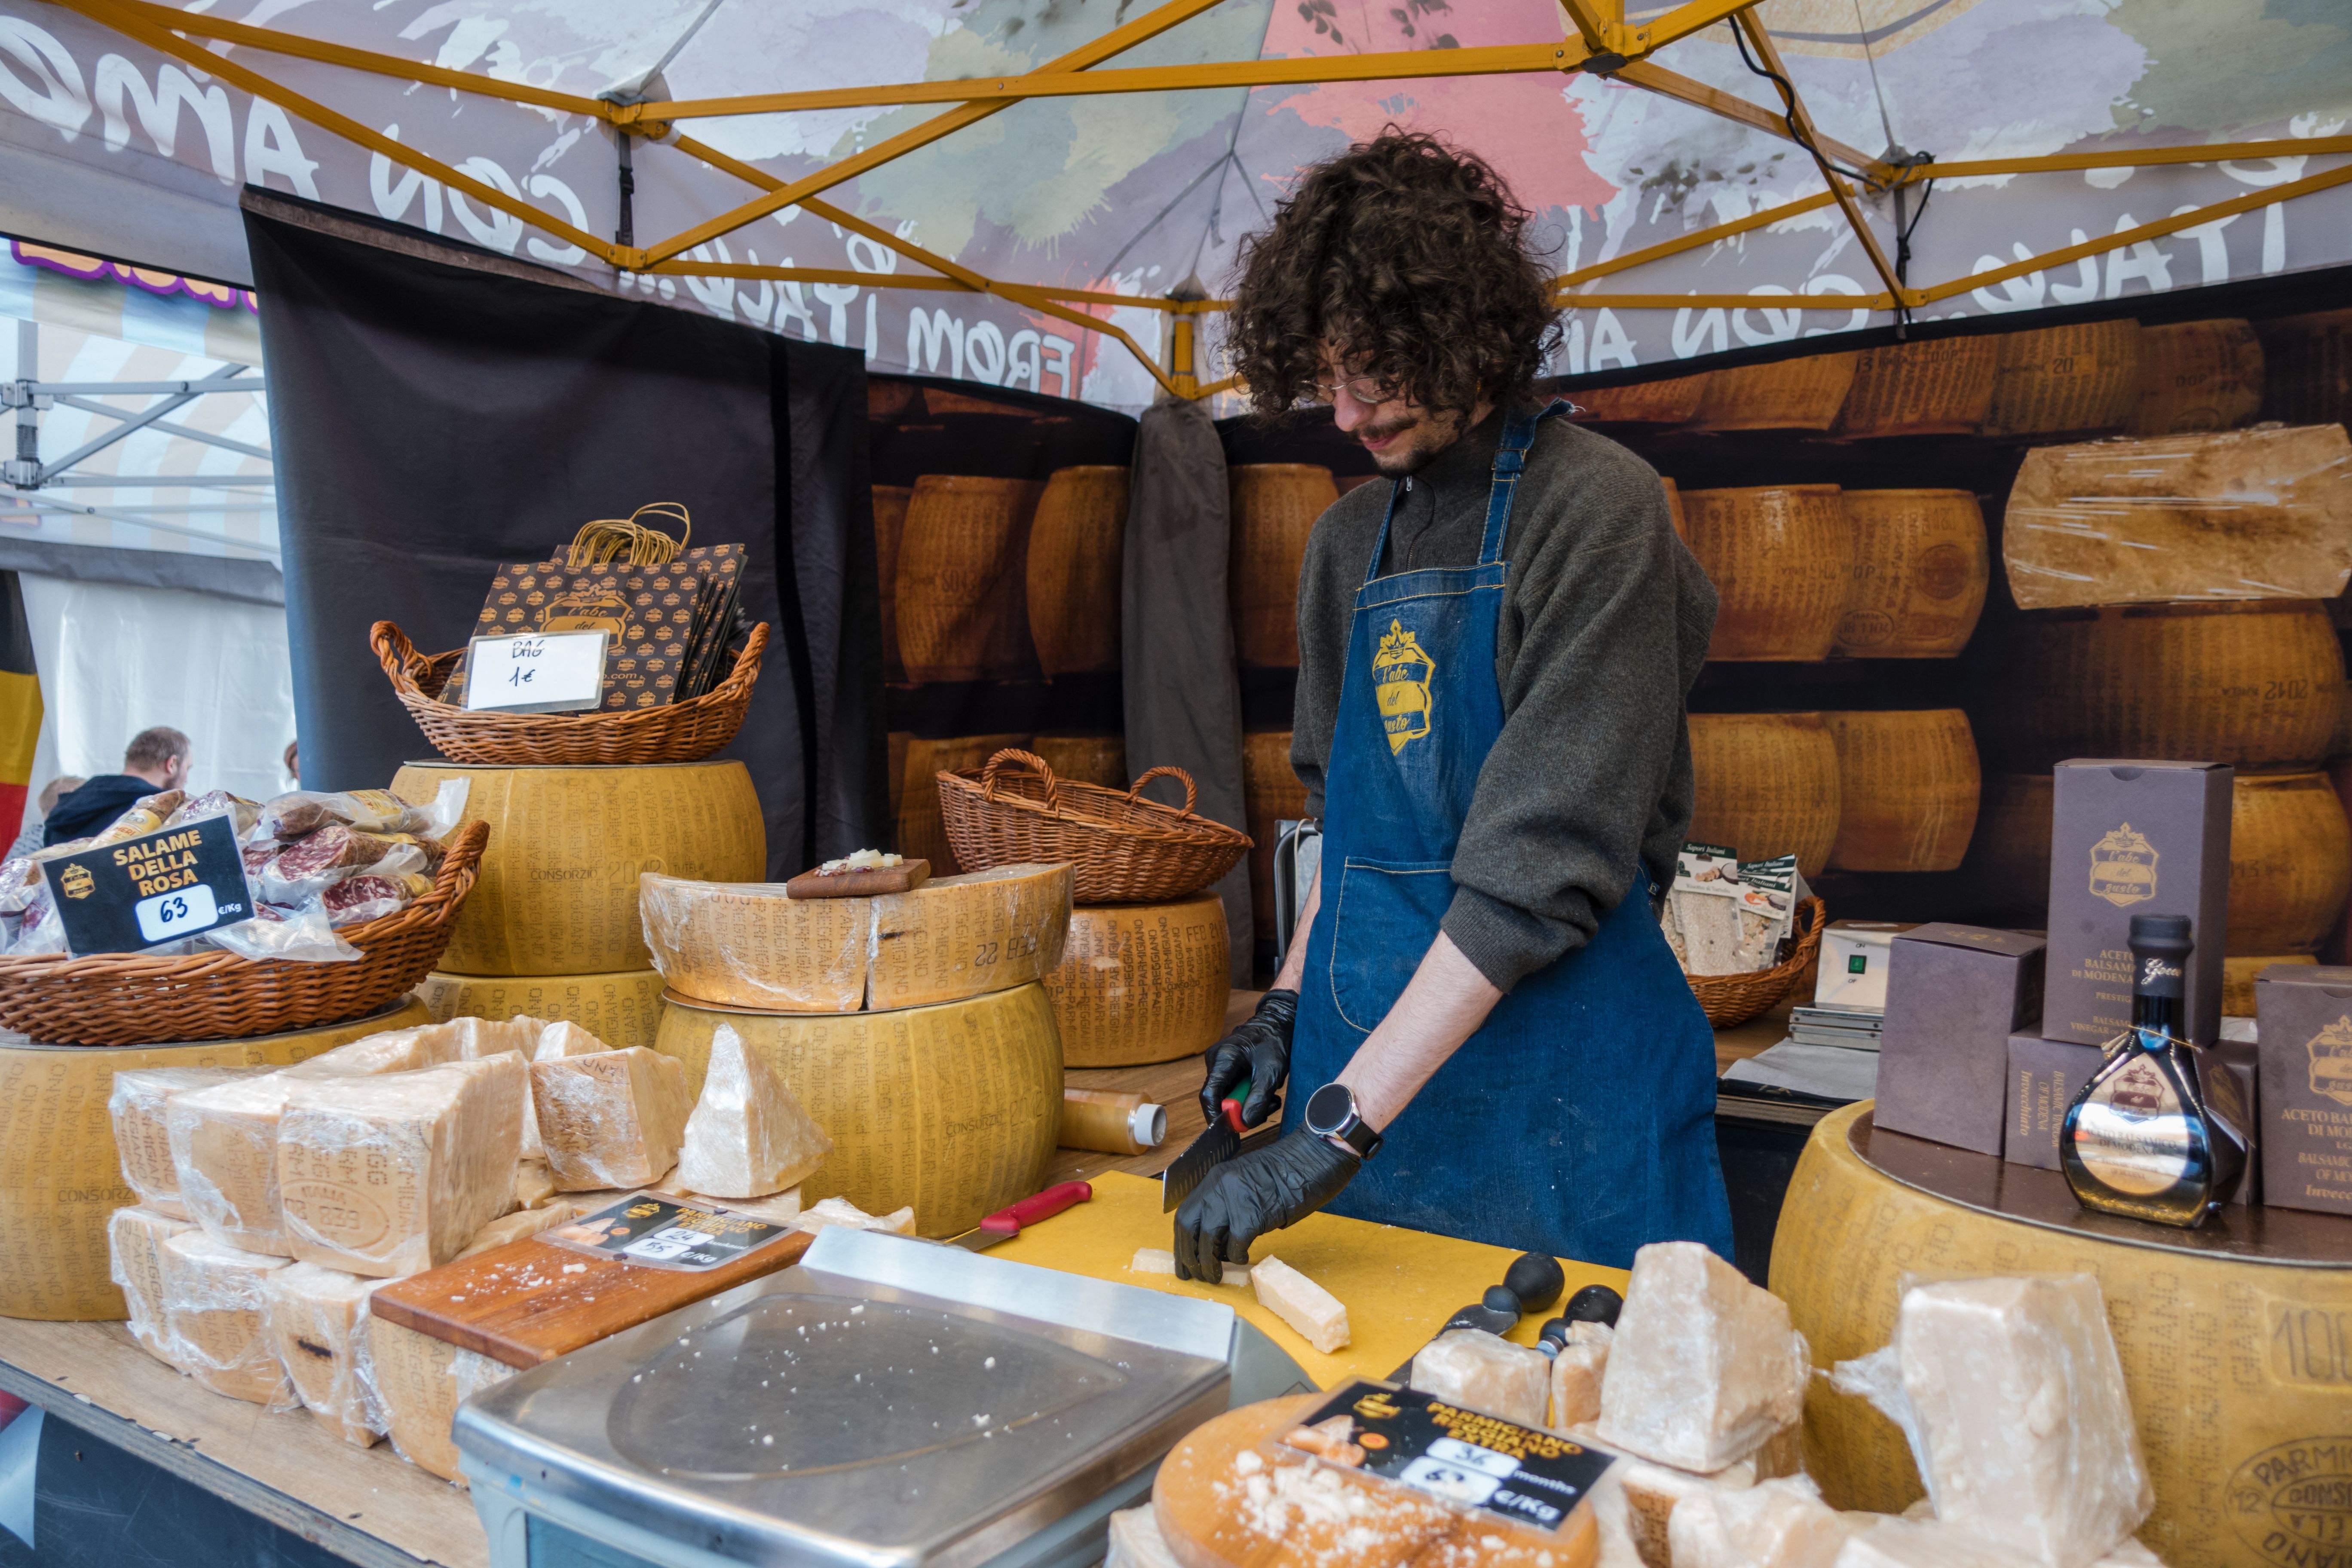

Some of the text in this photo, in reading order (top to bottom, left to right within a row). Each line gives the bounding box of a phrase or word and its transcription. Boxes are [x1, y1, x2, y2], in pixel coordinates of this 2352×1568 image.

[512, 640, 545, 658] BAG
[1387, 691, 1400, 706] del
[113, 829, 202, 866] SALAME
[128, 850, 199, 881] DELLA
[531, 869, 598, 881] CONSORZIO
[674, 863, 704, 874] TUTELA
[138, 868, 199, 897] ROSA
[160, 897, 188, 923] 63
[218, 903, 242, 915] €/Kg
[2072, 969, 2082, 978] DI
[2095, 992, 2131, 1003] PRESTIG
[2019, 1071, 2033, 1136] Invecchiato
[945, 1112, 1003, 1136] CONSORZIO
[2281, 1109, 2327, 1123] ACETO
[2308, 1124, 2324, 1136] DI
[675, 1213, 750, 1234] REGGIANO
[676, 1207, 768, 1230] PARMIGIANO
[676, 1222, 726, 1236] EXTRA
[665, 1230, 694, 1241] 24
[680, 1251, 718, 1263] €/Kg
[1427, 1402, 1583, 1455] PARMIGIANO
[1431, 1412, 1561, 1459] REGGIANO
[1446, 1428, 1527, 1461] EXTRA
[1513, 1470, 1578, 1496] months
[1494, 1489, 1562, 1522] €/Kg
